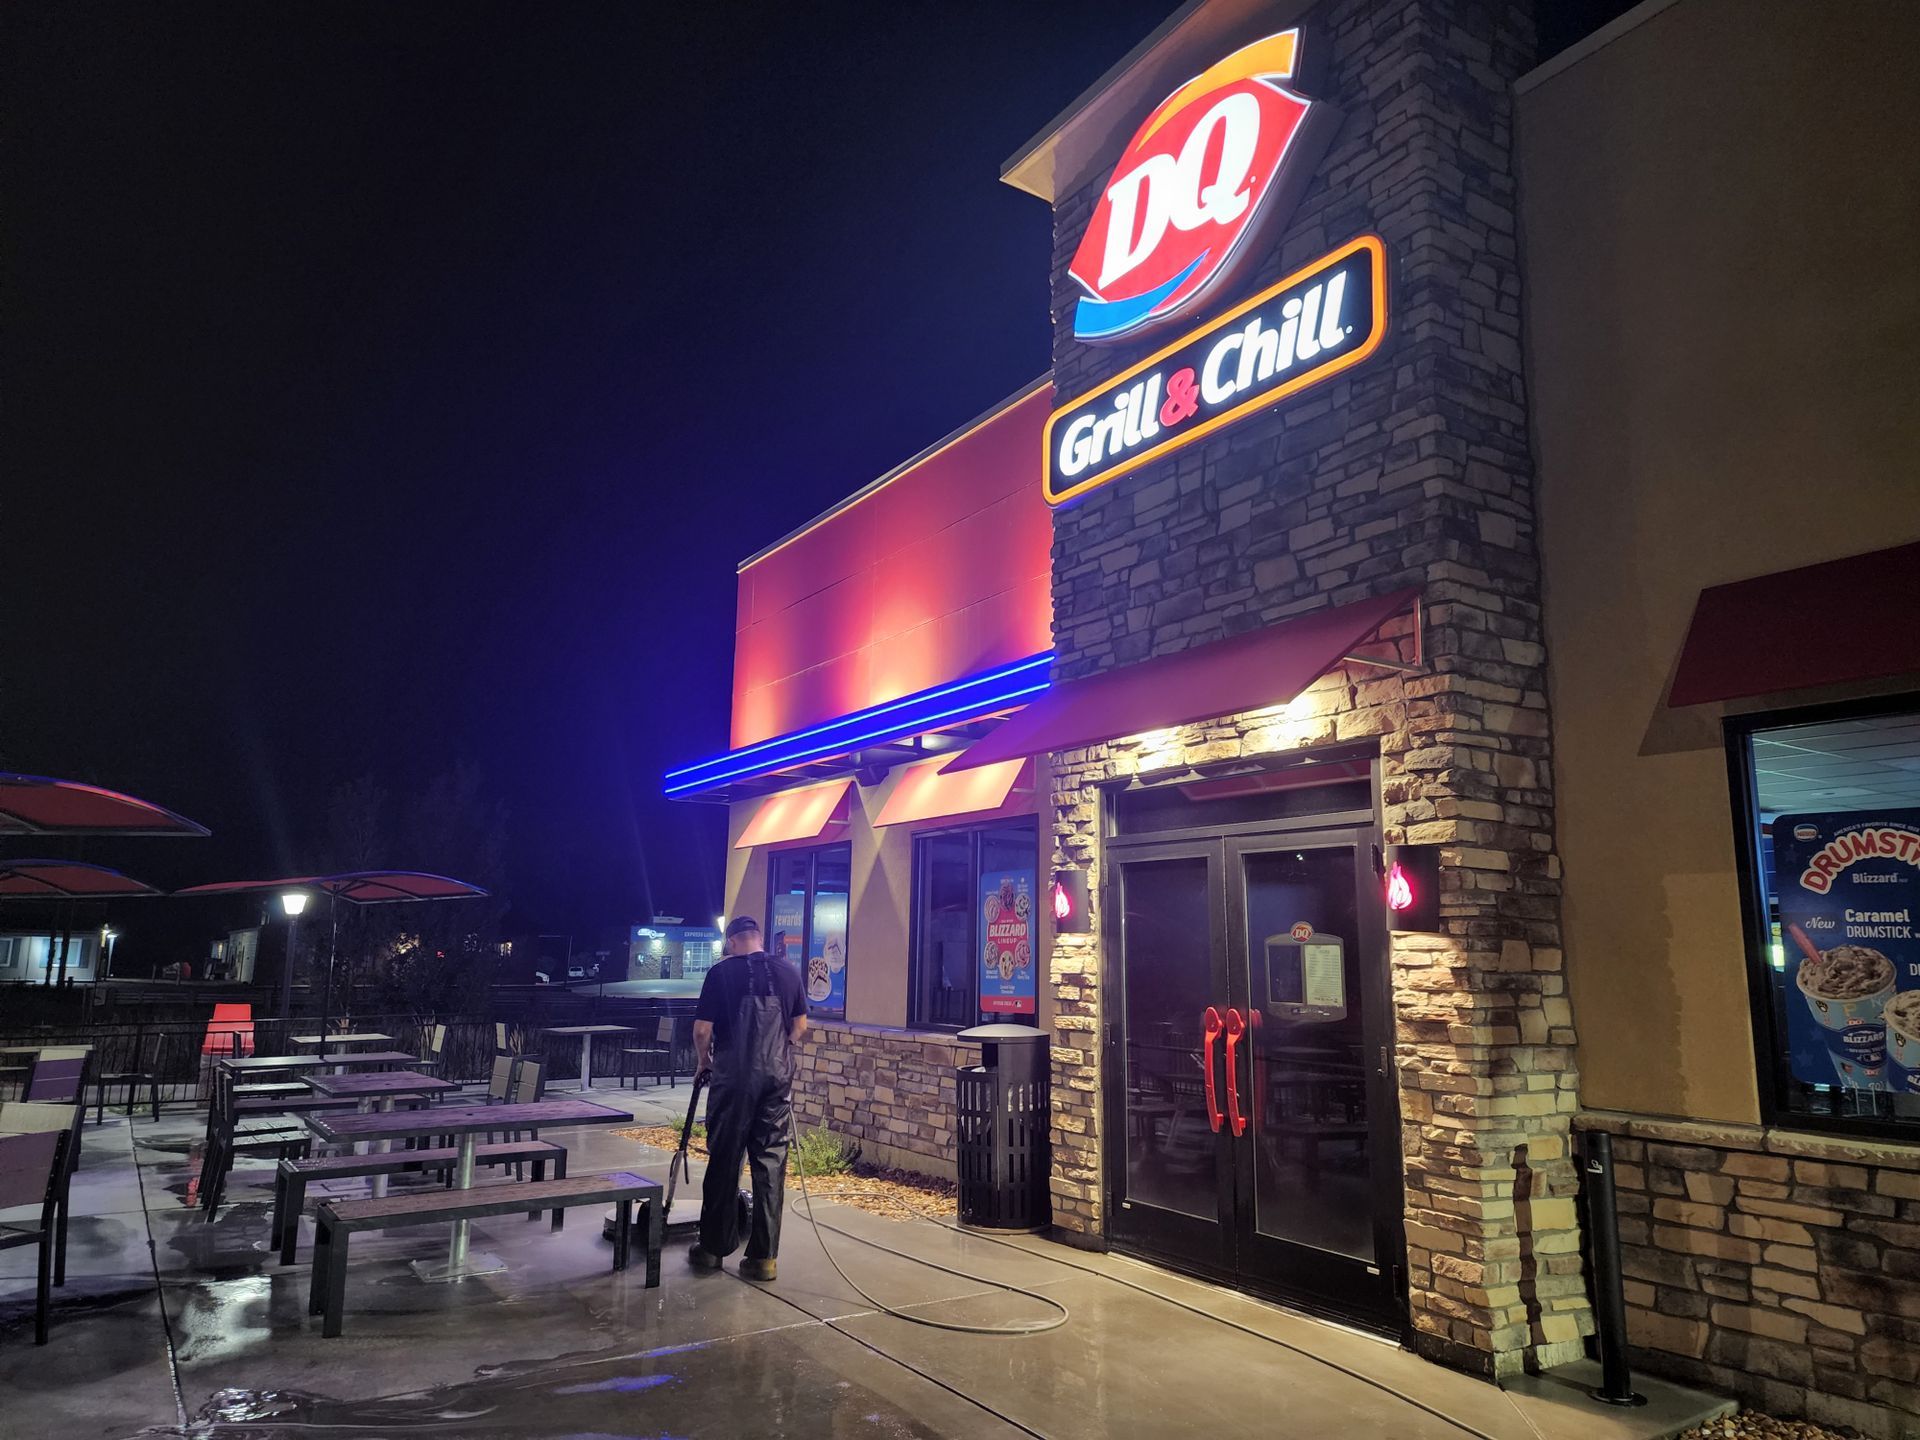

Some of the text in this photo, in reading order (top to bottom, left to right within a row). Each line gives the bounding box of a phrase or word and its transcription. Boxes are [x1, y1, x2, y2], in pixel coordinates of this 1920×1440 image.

[1098, 92, 1261, 291] DQ
[1852, 872, 1898, 884] Blizzard
[775, 911, 802, 927] rewards
[1805, 916, 1836, 929] New
[1844, 908, 1910, 923] Caramel
[989, 923, 1026, 937] BLIZZARD
[1295, 928, 1309, 938] DQ
[1846, 925, 1912, 939] DRUMSTICK
[1843, 1031, 1885, 1044] BLIZZARD
